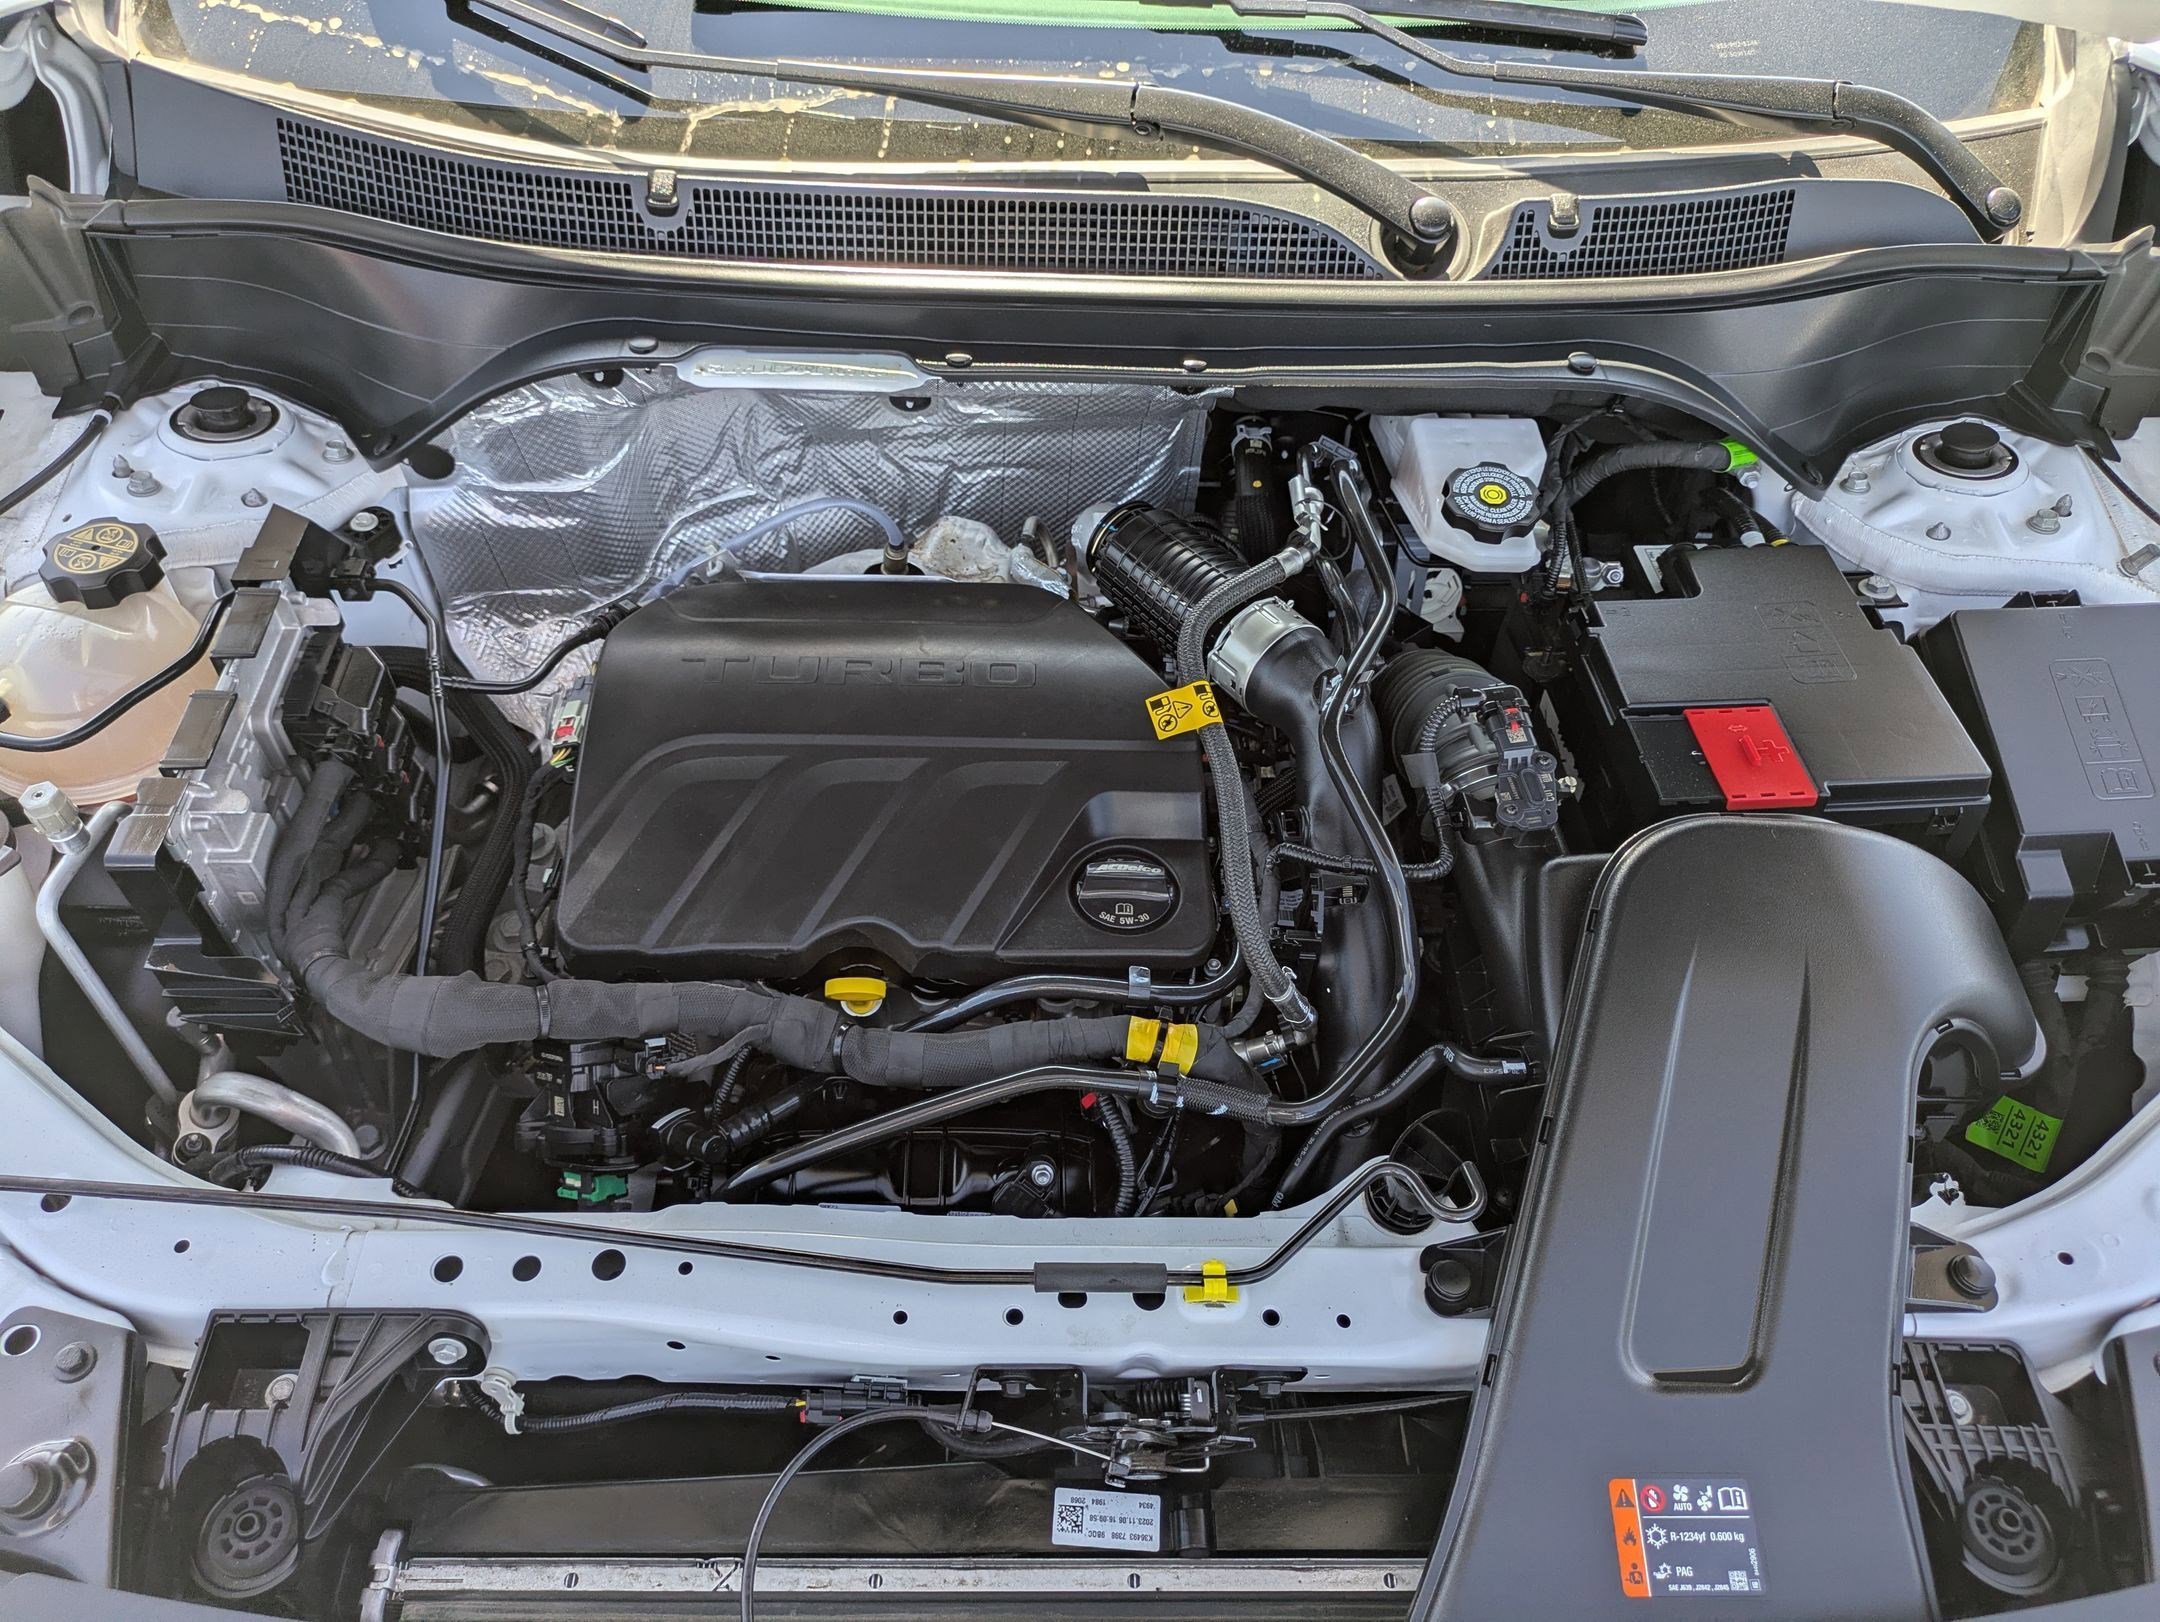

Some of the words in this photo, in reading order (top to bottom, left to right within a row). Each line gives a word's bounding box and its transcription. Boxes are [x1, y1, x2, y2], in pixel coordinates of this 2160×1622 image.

[681, 655, 1037, 687] TURBO
[1096, 864, 1162, 873] ACDelco
[1099, 912, 1116, 923] SAE
[1120, 913, 1150, 924] 5W-30
[592, 1098, 600, 1116] H
[2002, 1108, 2026, 1148] 4321
[2024, 1119, 2050, 1159] 4321
[1674, 1502, 1692, 1512] AUTO
[1670, 1532, 1707, 1543] R-1234yf
[1710, 1532, 1733, 1542] 0.600
[1734, 1532, 1745, 1543] kg
[1676, 1566, 1694, 1577] PAG
